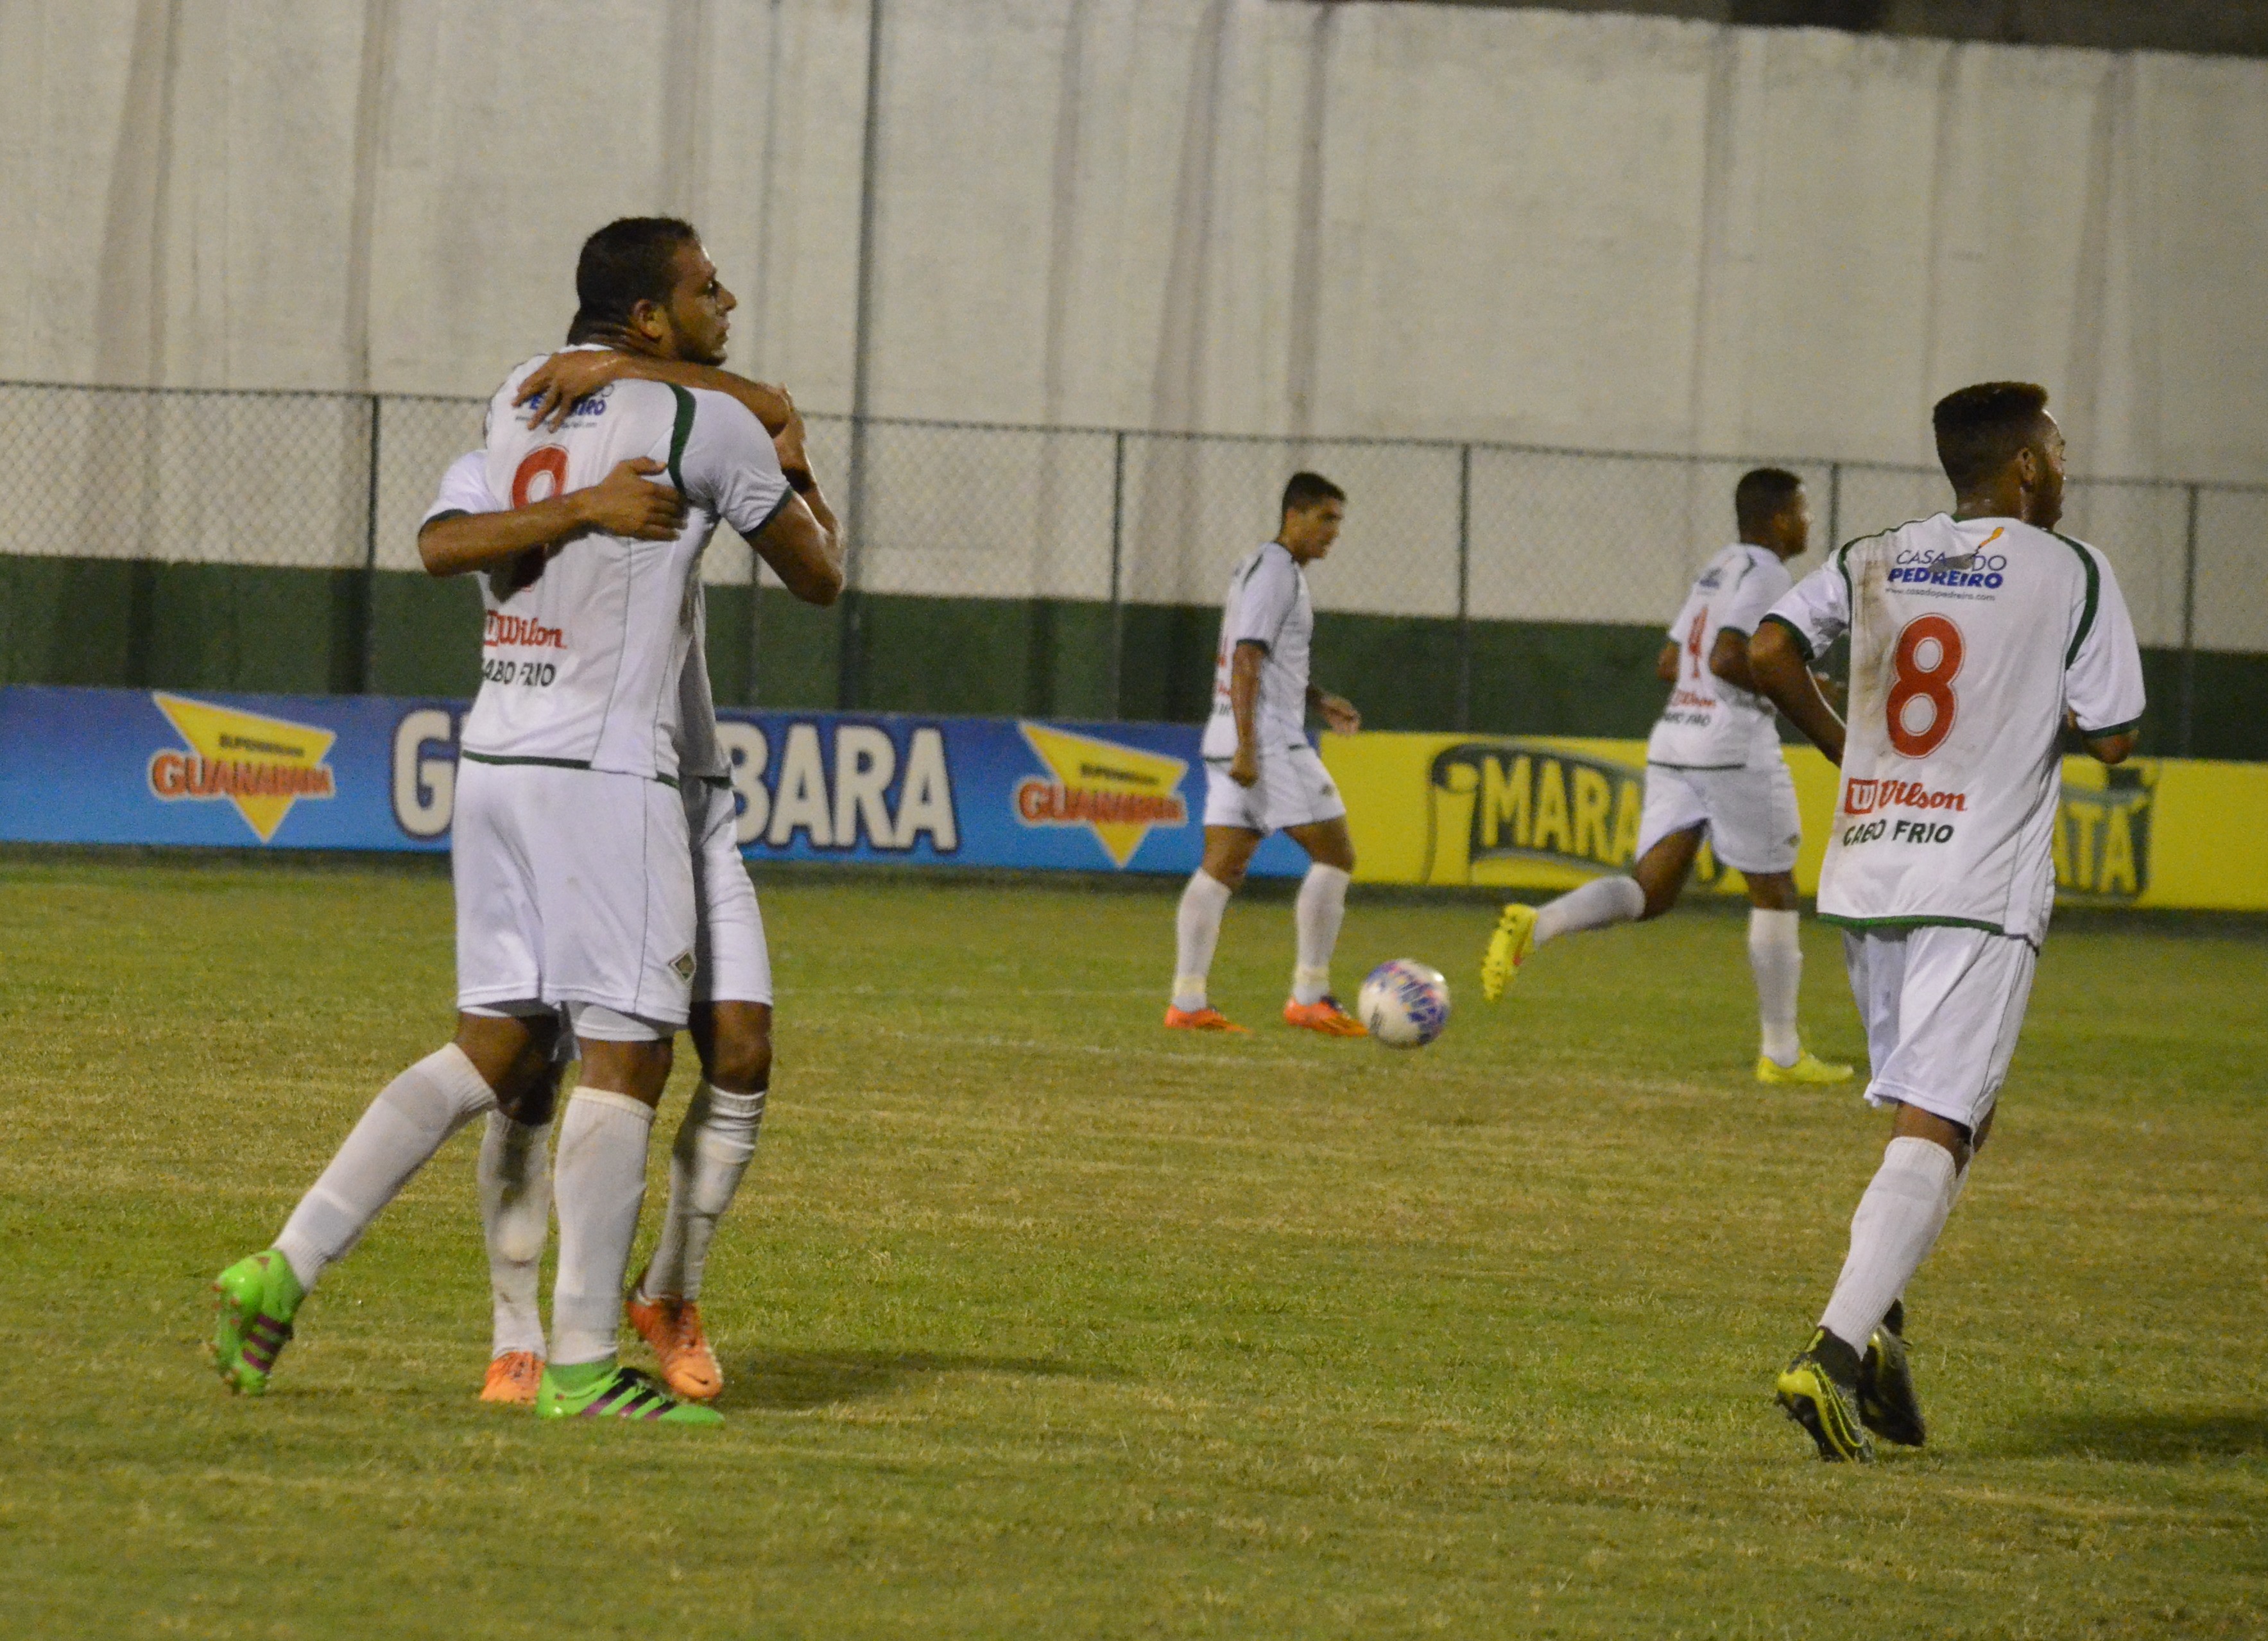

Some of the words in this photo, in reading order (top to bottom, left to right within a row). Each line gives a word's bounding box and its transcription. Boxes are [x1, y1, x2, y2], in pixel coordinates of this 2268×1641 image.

[1896, 549, 1947, 565] CASA
[1972, 554, 2007, 571] DO
[1887, 567, 2004, 589] PEDREIRO
[483, 658, 516, 685] ABO
[517, 662, 557, 687] FRIO
[1887, 613, 1965, 759] 8
[1843, 818, 1887, 846] CABO
[1892, 820, 1955, 844] FRIO
